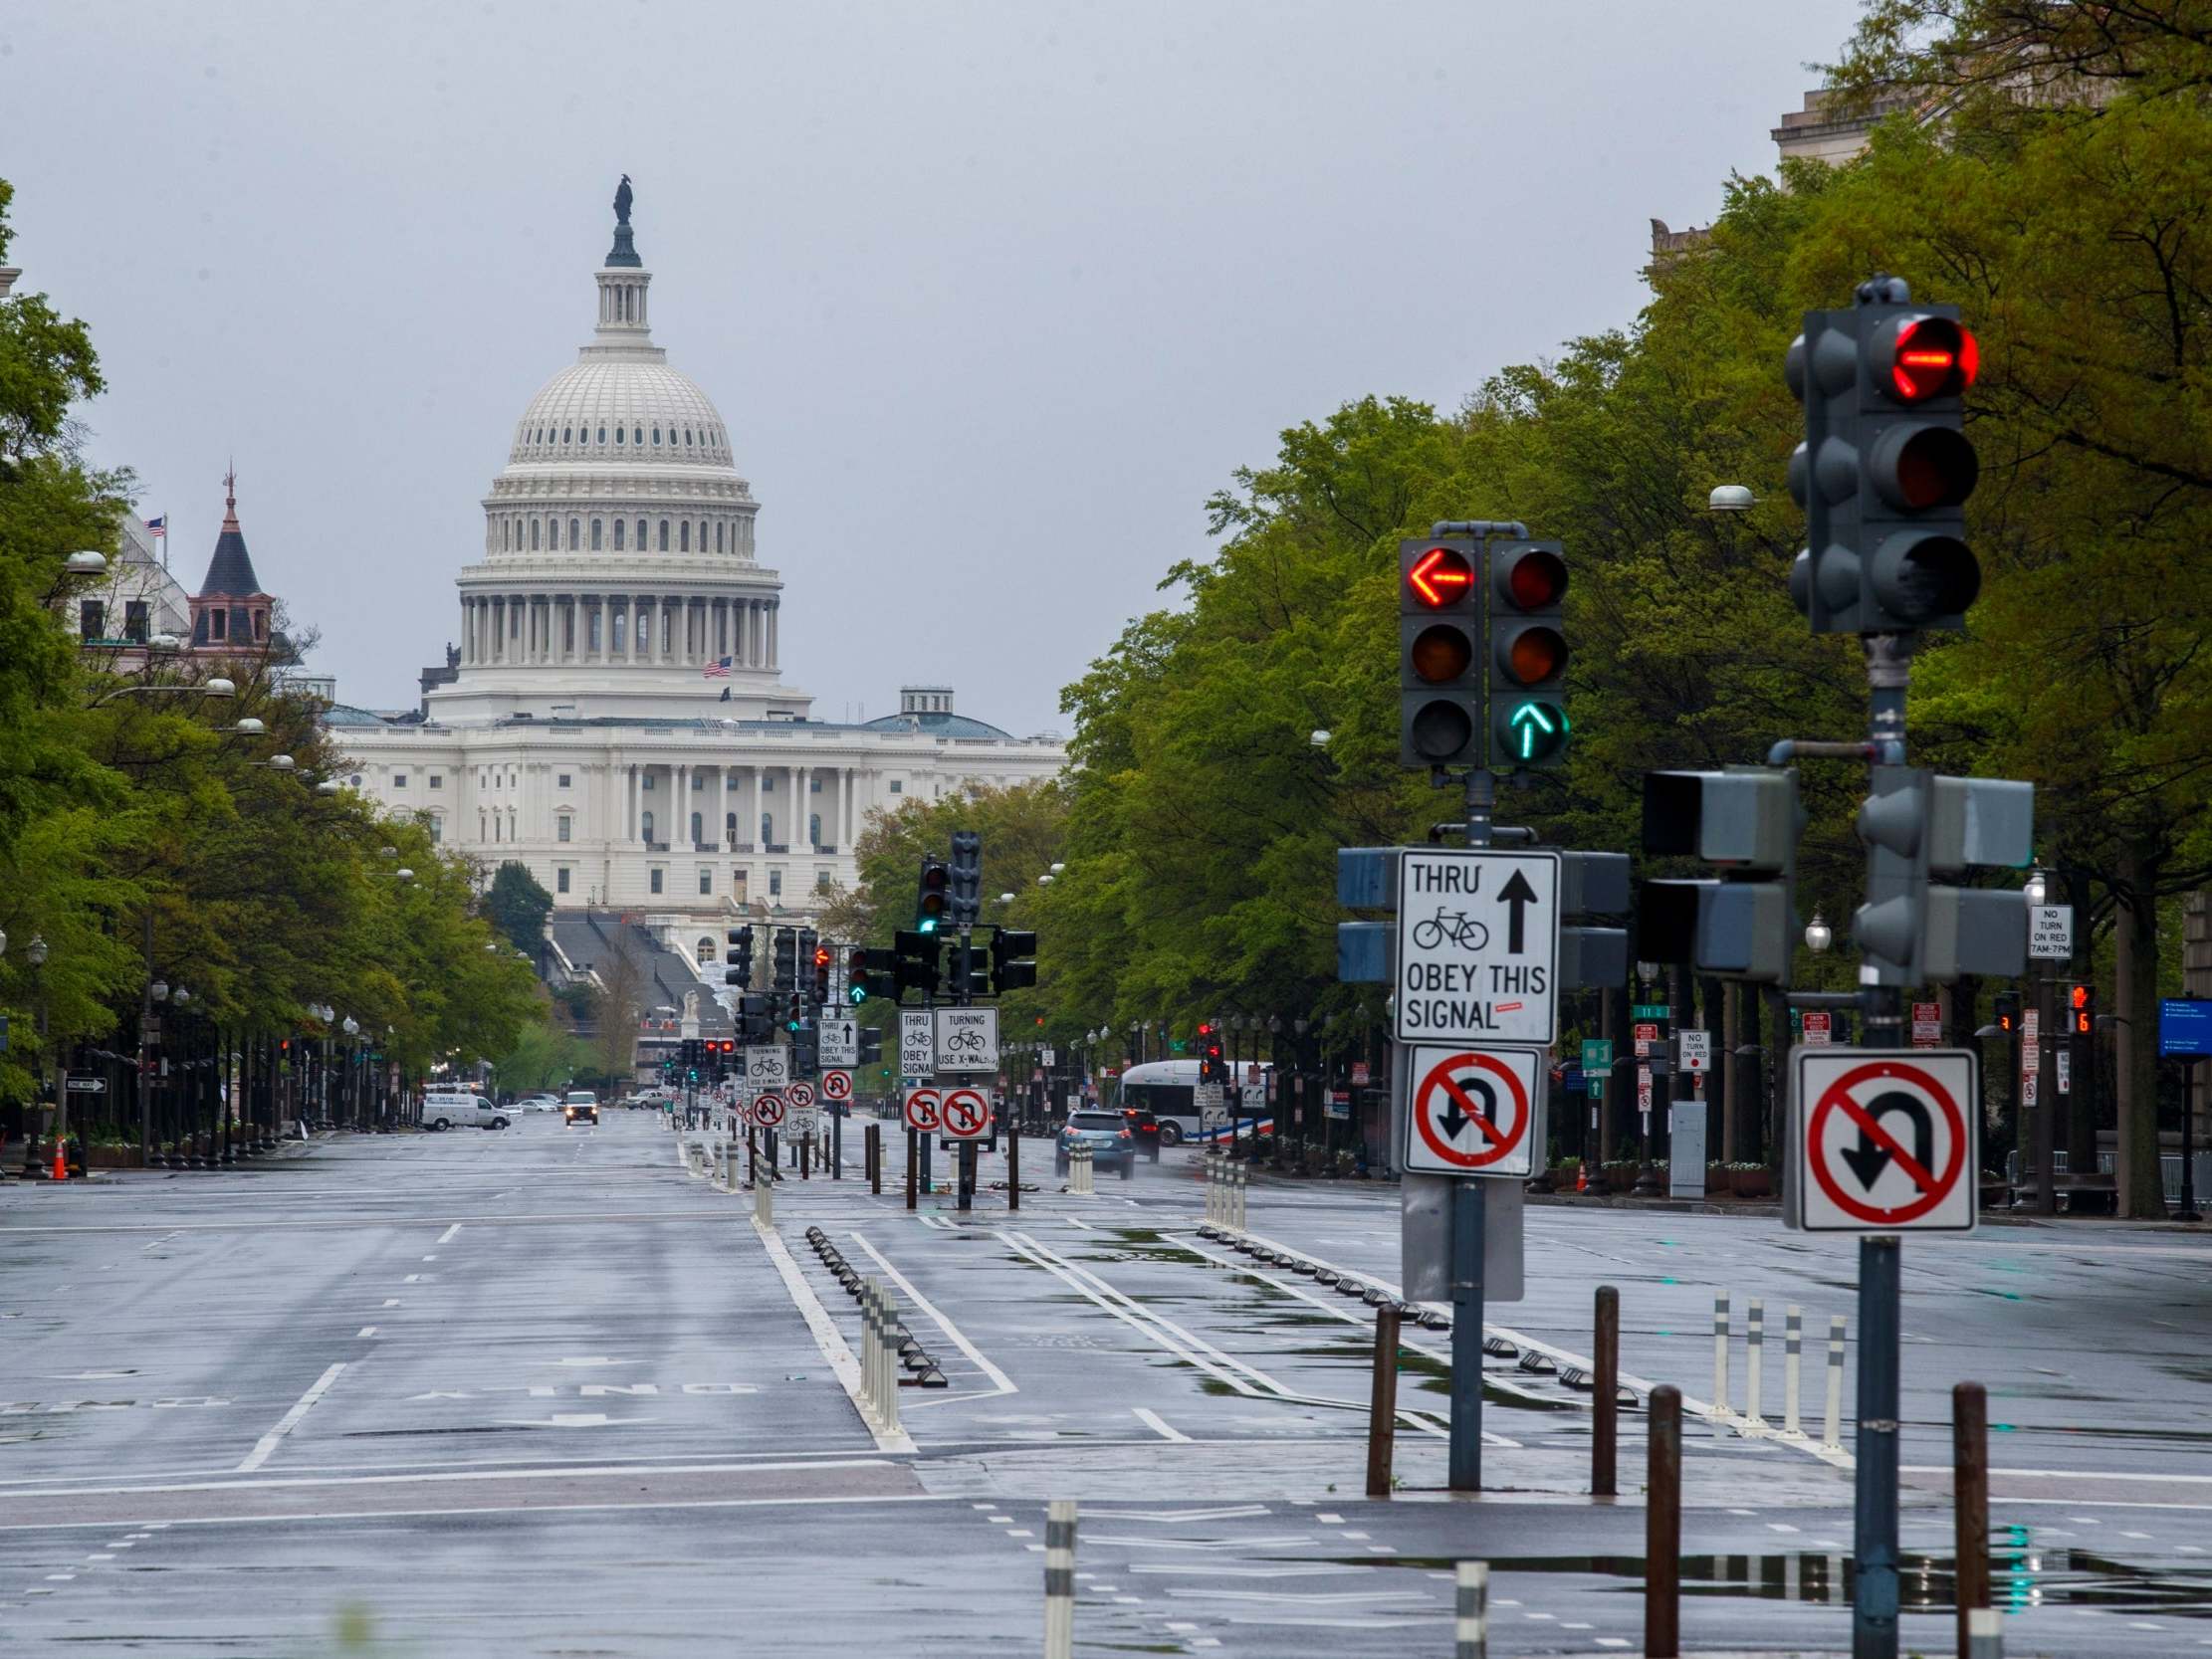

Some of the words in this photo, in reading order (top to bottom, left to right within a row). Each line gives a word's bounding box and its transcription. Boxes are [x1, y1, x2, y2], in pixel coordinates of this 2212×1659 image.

[1412, 864, 1481, 894] THRU
[1407, 962, 1477, 992] OBEY
[1489, 965, 1546, 994] THIS
[905, 1015, 929, 1026] THRU
[948, 1015, 985, 1025] TURNING
[1407, 999, 1500, 1029] SIGNAL
[2080, 1013, 2089, 1032] 6
[903, 1050, 927, 1061] OBEY
[938, 1055, 955, 1065] USE
[404, 1383, 763, 1397] ONLY
